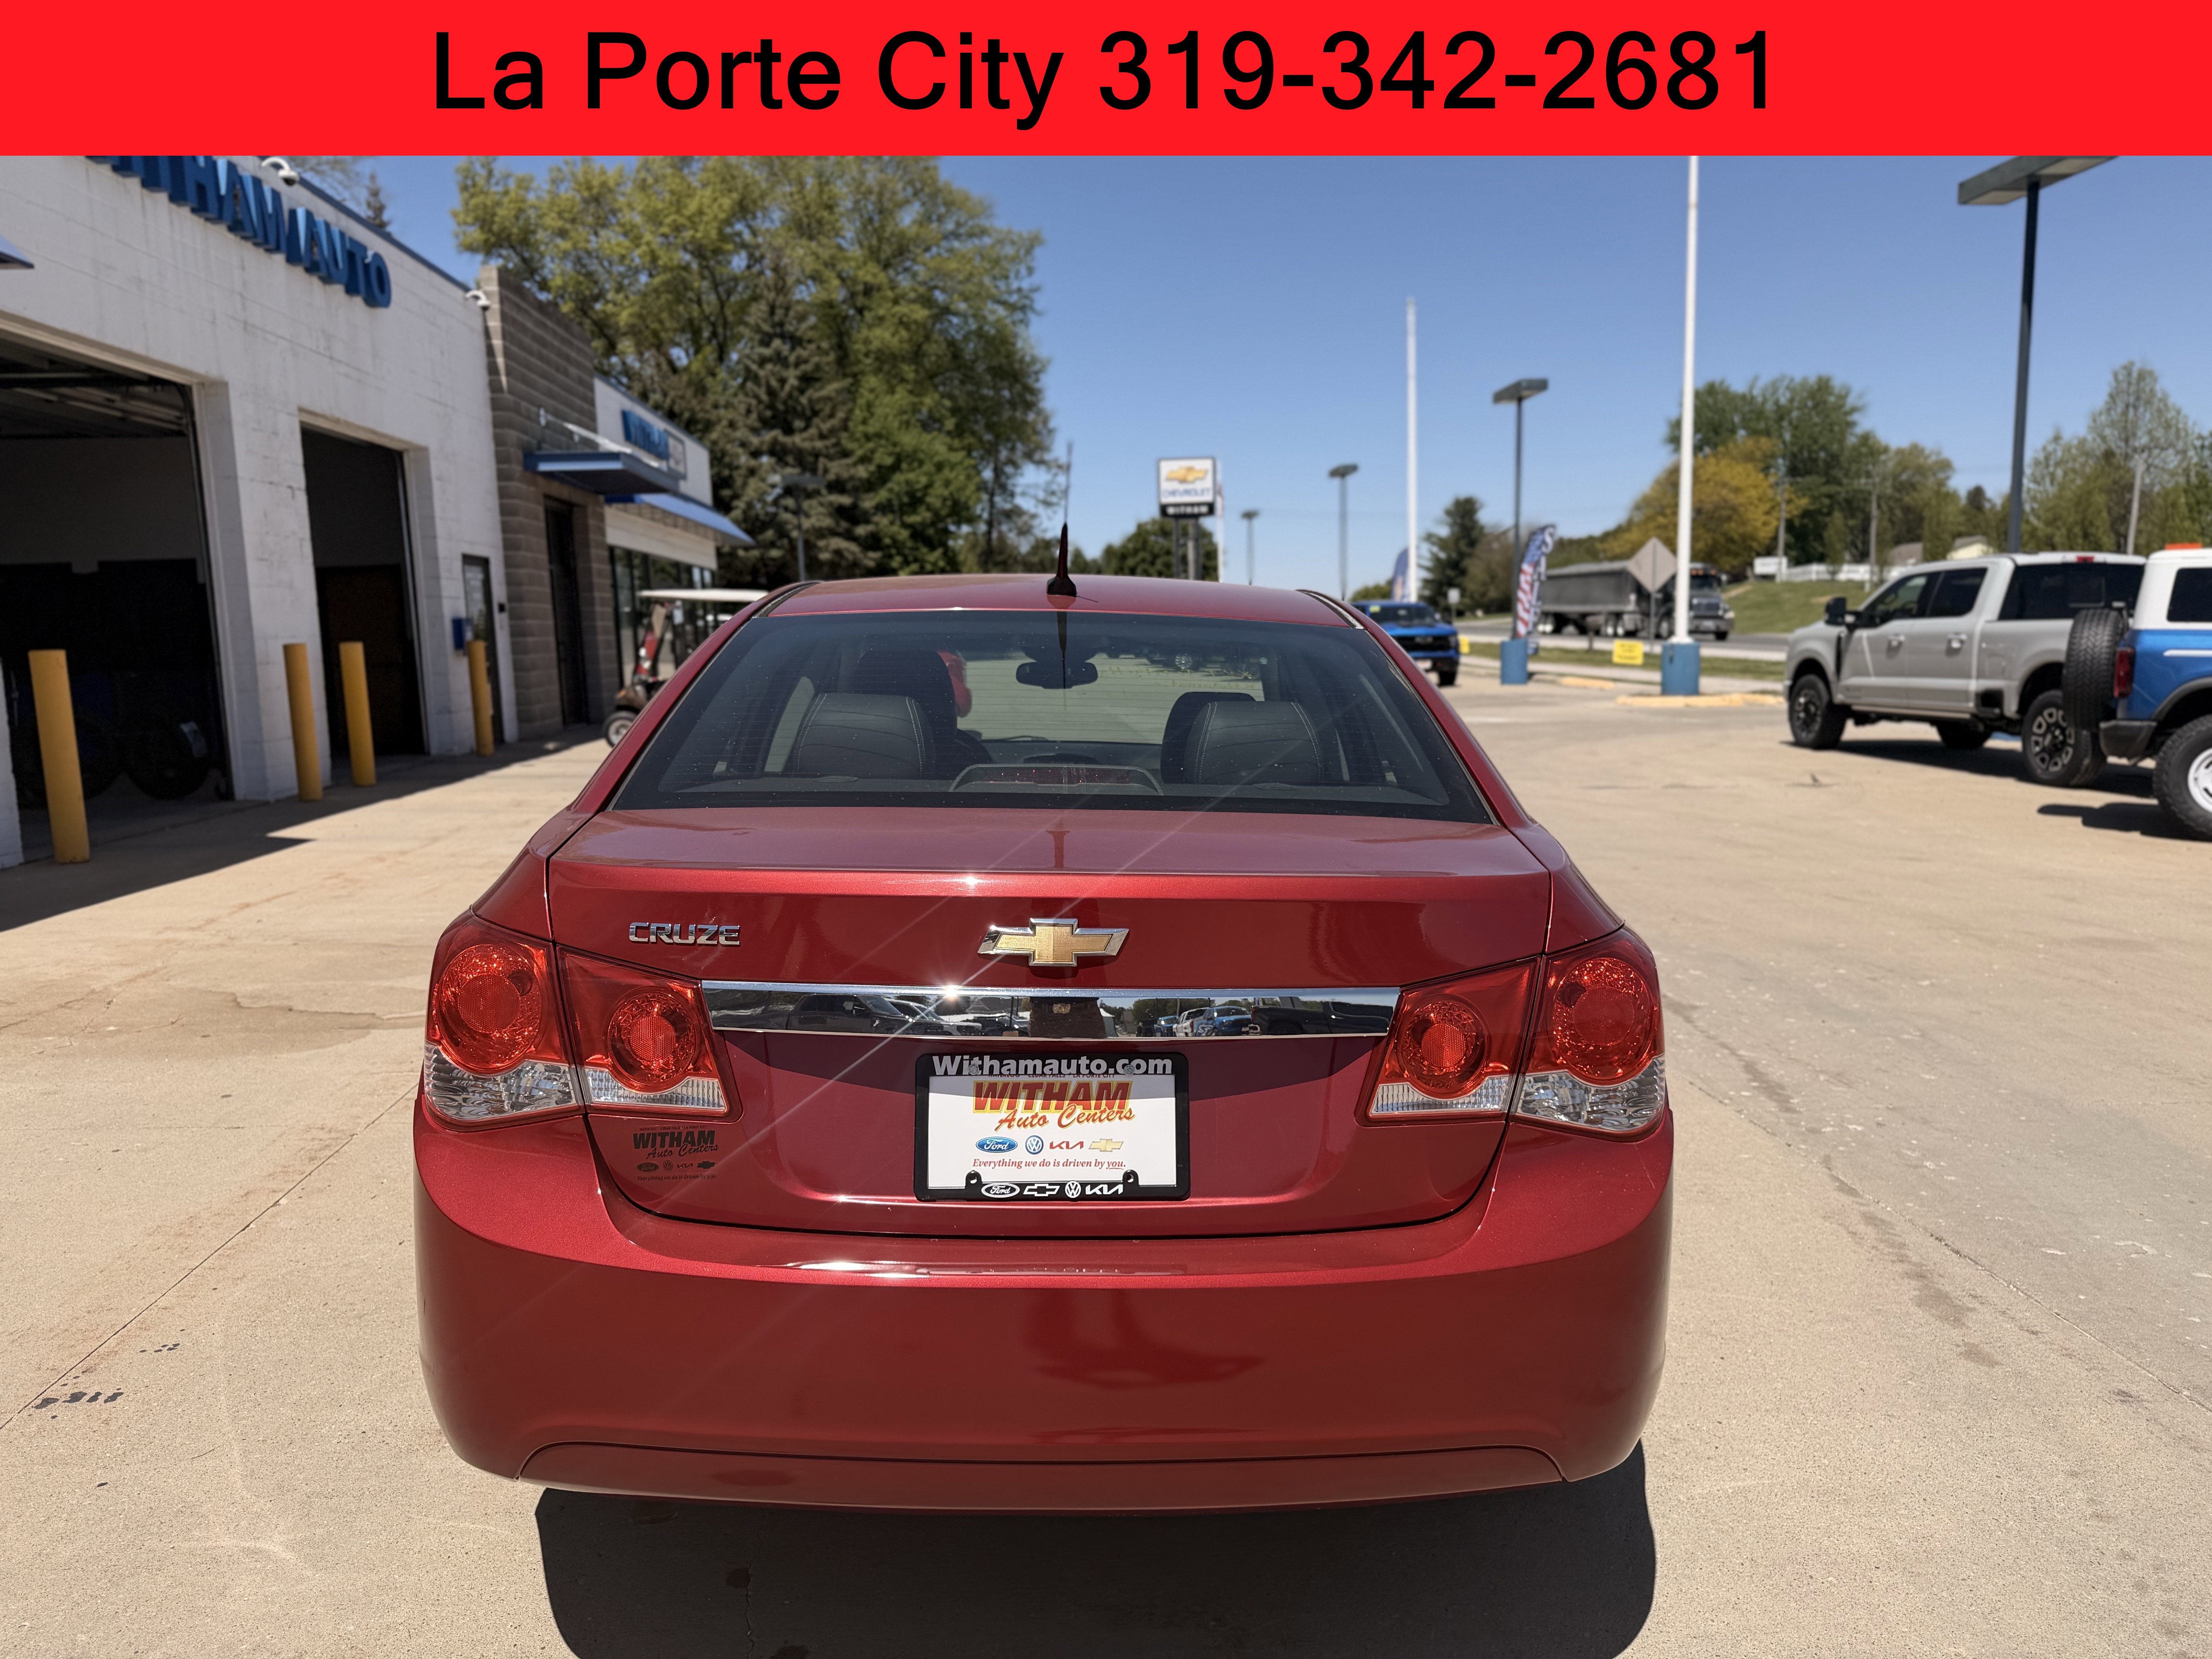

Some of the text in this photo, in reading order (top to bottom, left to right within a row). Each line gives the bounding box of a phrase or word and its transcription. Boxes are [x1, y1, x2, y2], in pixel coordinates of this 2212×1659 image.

[629, 922, 740, 945] CRUZE
[932, 1055, 1172, 1075] Withamauto.com
[973, 1080, 1133, 1113] WITHAM
[994, 1103, 1135, 1132] Auto Centers
[633, 1130, 715, 1149] WITHAM
[646, 1144, 719, 1160] Auto Centers
[972, 1159, 1023, 1169] Everything
[1039, 1159, 1051, 1167] do
[1053, 1159, 1060, 1167] is
[1062, 1159, 1092, 1167] driven
[1094, 1159, 1106, 1169] by
[1106, 1161, 1126, 1170] you.
